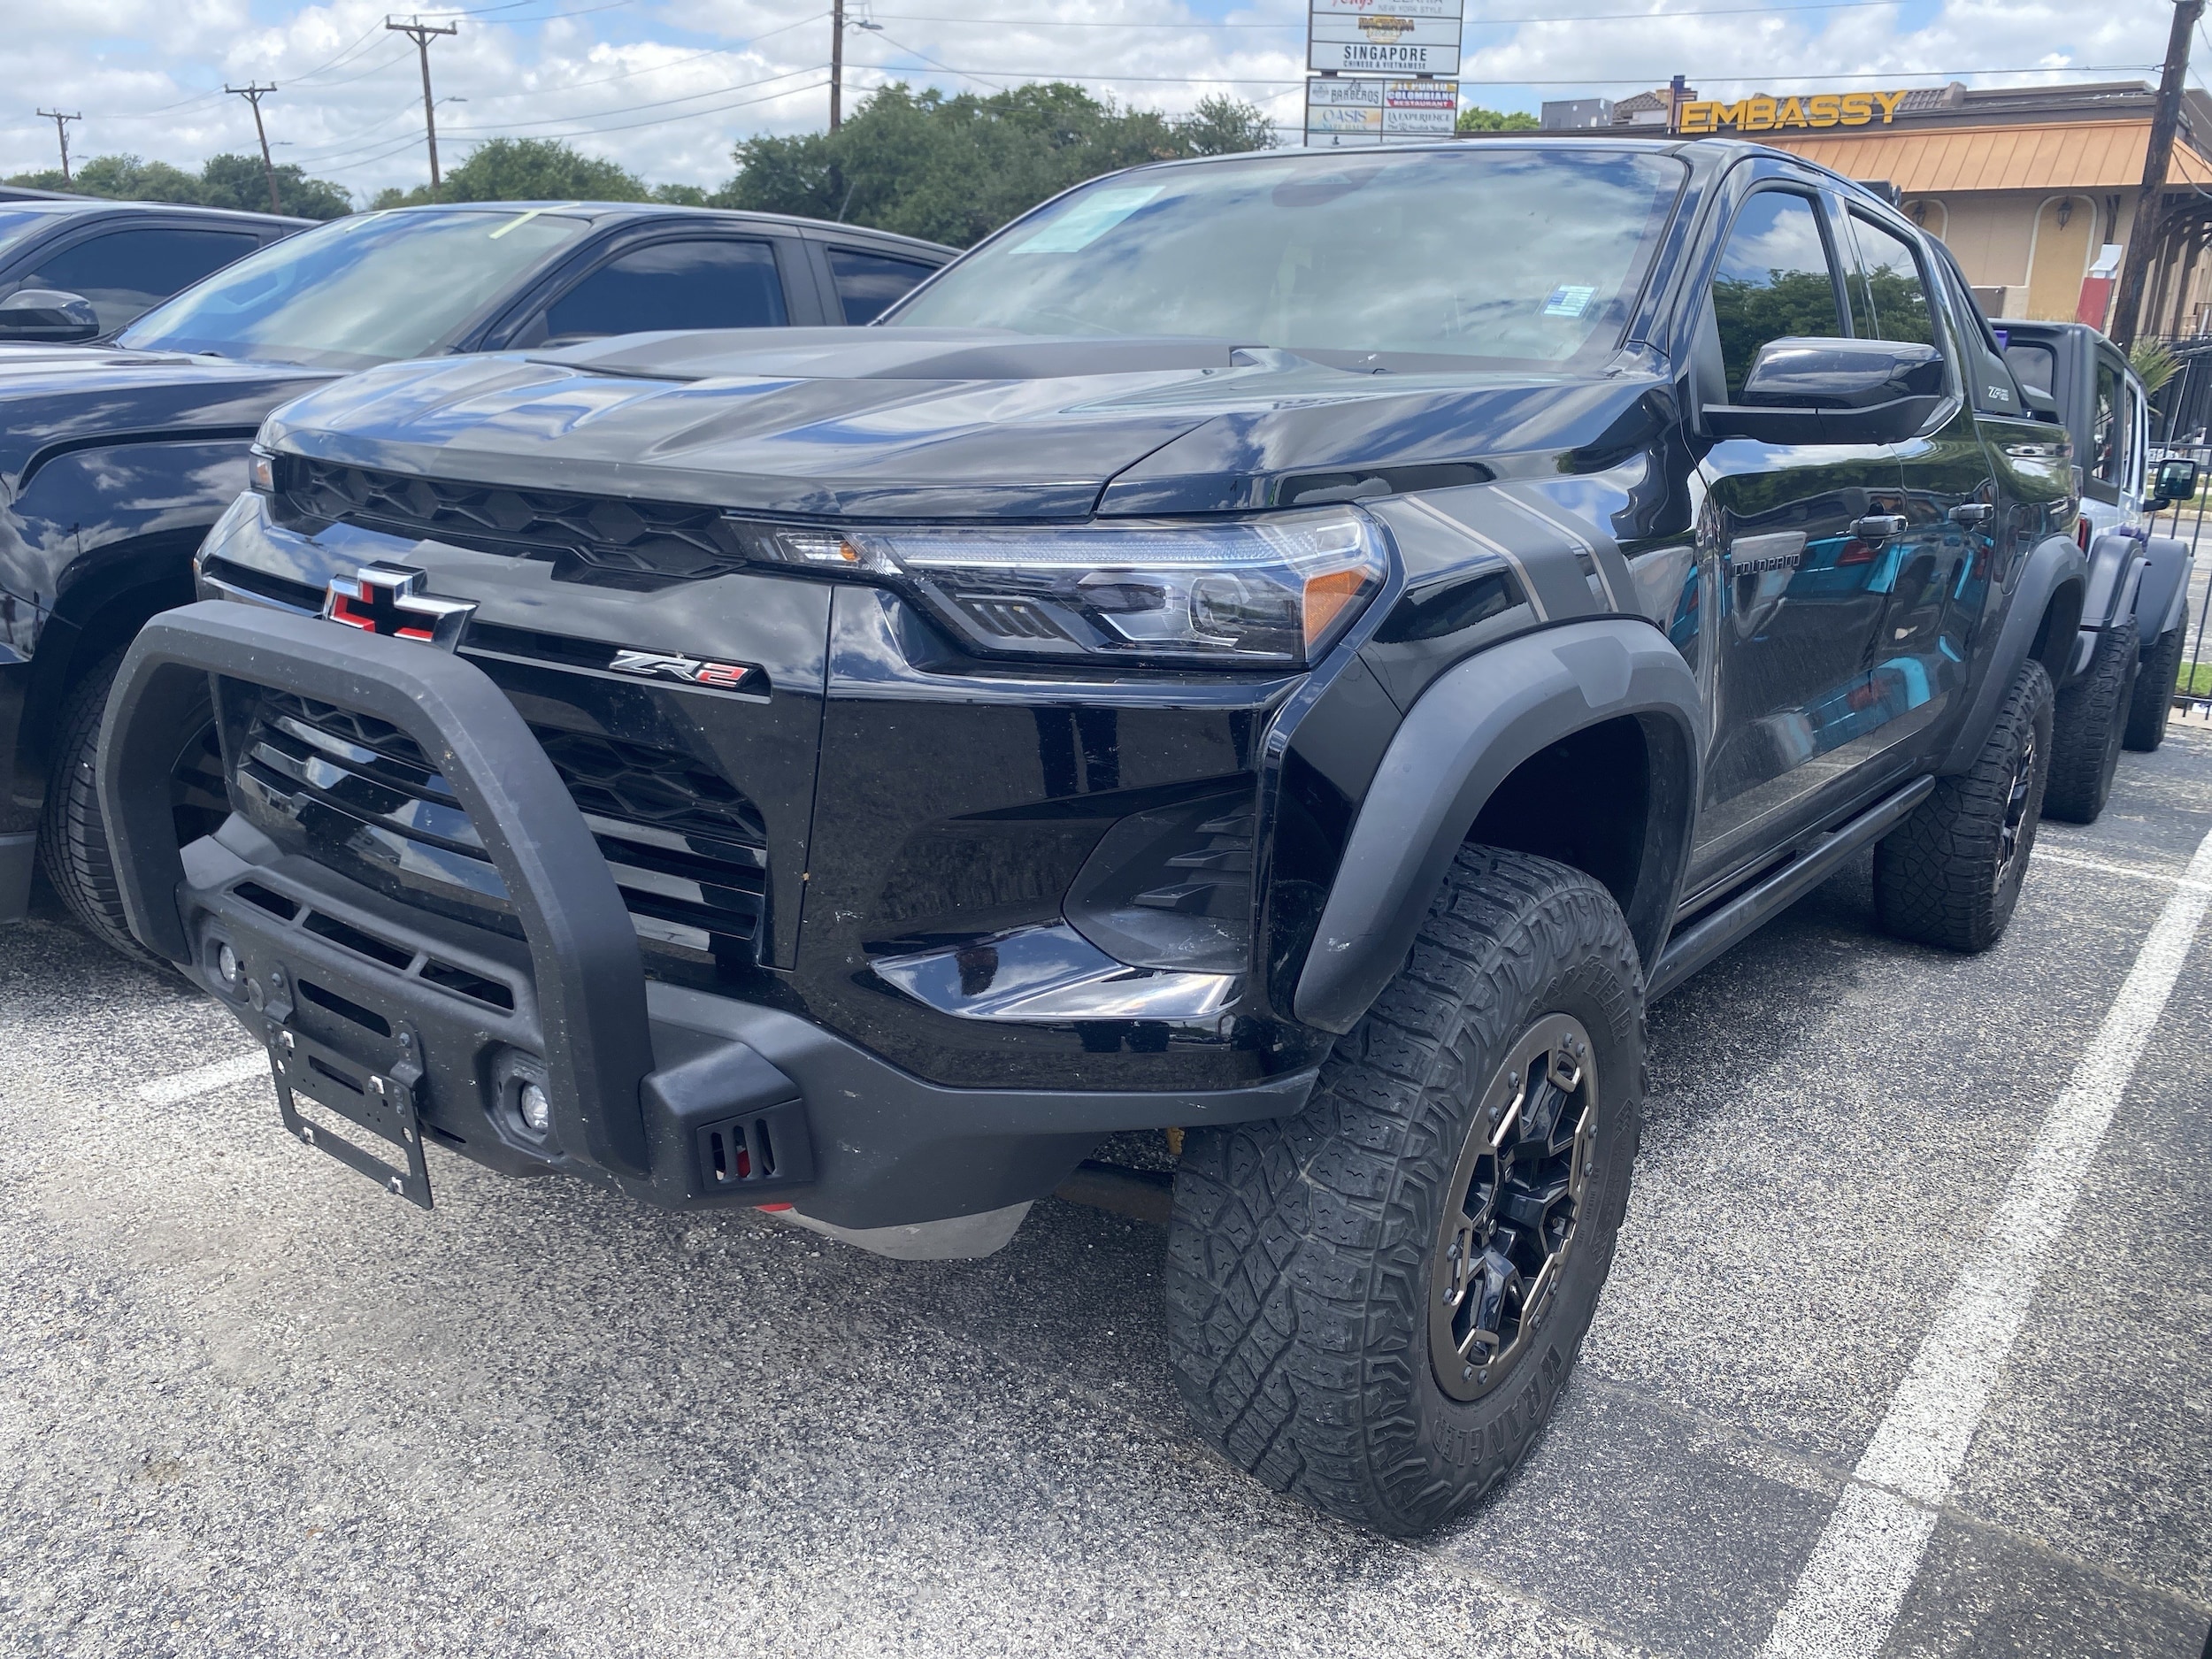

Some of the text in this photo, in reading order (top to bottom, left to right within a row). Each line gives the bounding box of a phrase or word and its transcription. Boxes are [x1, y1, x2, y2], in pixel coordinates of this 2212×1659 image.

[1344, 46, 1427, 61] SINGAPORE
[1331, 89, 1379, 104] BARBEROS
[1323, 109, 1368, 123] OASIS
[1679, 89, 1908, 134] EMBASSY
[1733, 553, 1800, 577] COLORADO
[609, 649, 749, 687] ZR2
[1432, 1342, 1563, 1467] WRANGLER
